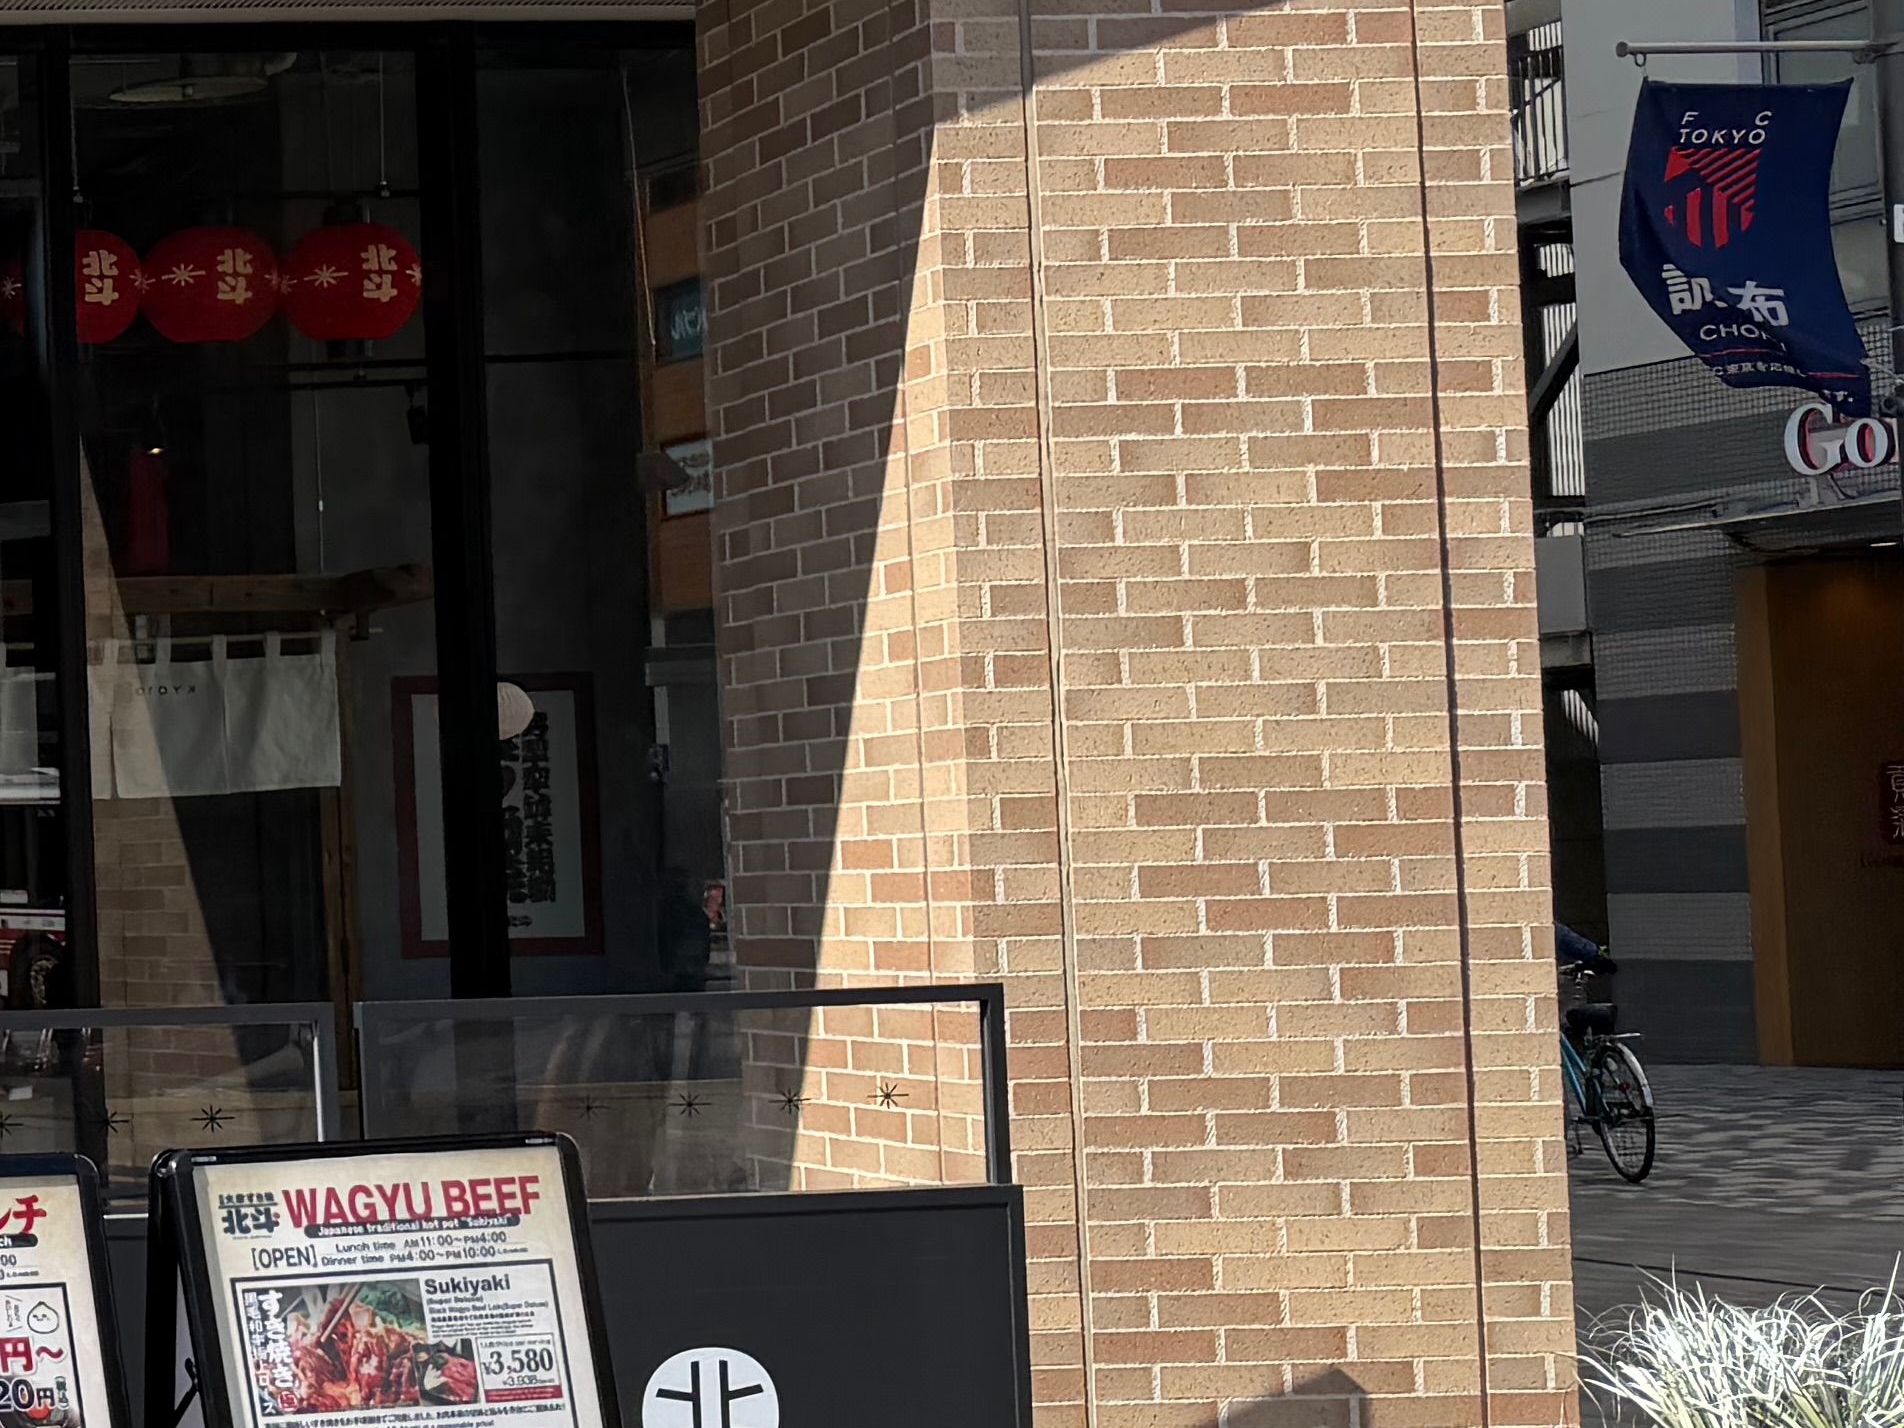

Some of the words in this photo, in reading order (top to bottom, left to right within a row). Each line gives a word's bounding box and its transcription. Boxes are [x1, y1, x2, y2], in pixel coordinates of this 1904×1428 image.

[1681, 111, 1700, 126] F
[1754, 110, 1773, 126] C
[1679, 128, 1766, 145] TOKYO
[281, 1180, 433, 1229] WAGYU
[441, 1175, 541, 1218] BEEF
[223, 1207, 280, 1235] 北斗
[335, 1241, 371, 1254] Lunch
[424, 1273, 511, 1296] Sukiyaki
